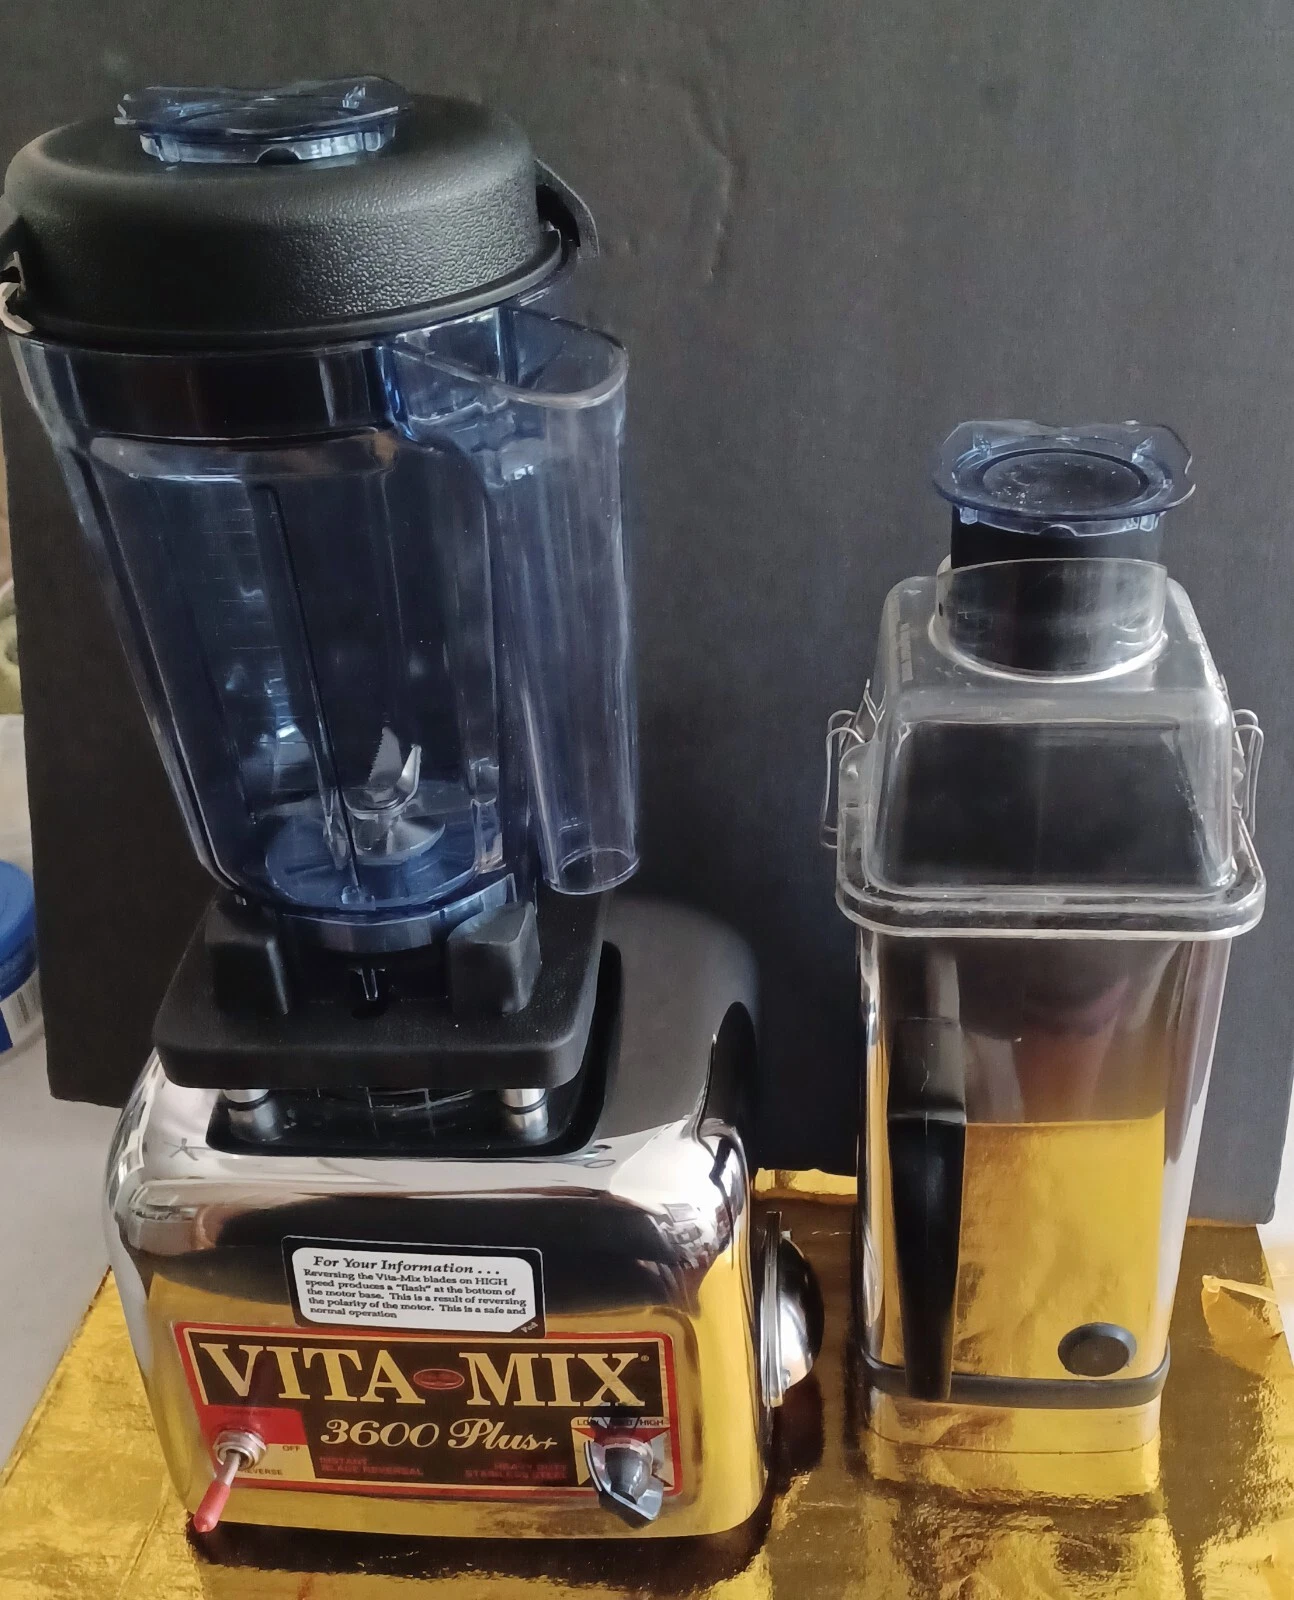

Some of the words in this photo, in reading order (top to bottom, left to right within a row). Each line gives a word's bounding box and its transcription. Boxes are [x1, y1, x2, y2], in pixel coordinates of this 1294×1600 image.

[313, 1256, 339, 1267] For
[343, 1258, 378, 1269] Your
[381, 1260, 473, 1274] Information
[304, 1268, 355, 1281] Reversing
[358, 1272, 374, 1280] the
[376, 1273, 420, 1282] Vita-Mix
[423, 1276, 457, 1284] blades
[475, 1278, 508, 1286] HIGH
[306, 1280, 334, 1288] speed
[338, 1282, 384, 1290] produces
[465, 1287, 502, 1296] bottom
[326, 1290, 356, 1298] motor
[358, 1290, 384, 1300] base.
[388, 1292, 411, 1301] This
[478, 1298, 526, 1308] reversing
[327, 1299, 367, 1310] polarity
[439, 1304, 462, 1312] This
[484, 1306, 504, 1314] safe
[310, 1308, 346, 1316] normal
[348, 1309, 398, 1318] operation
[199, 1342, 426, 1404] VITA
[320, 1419, 440, 1448] 3600
